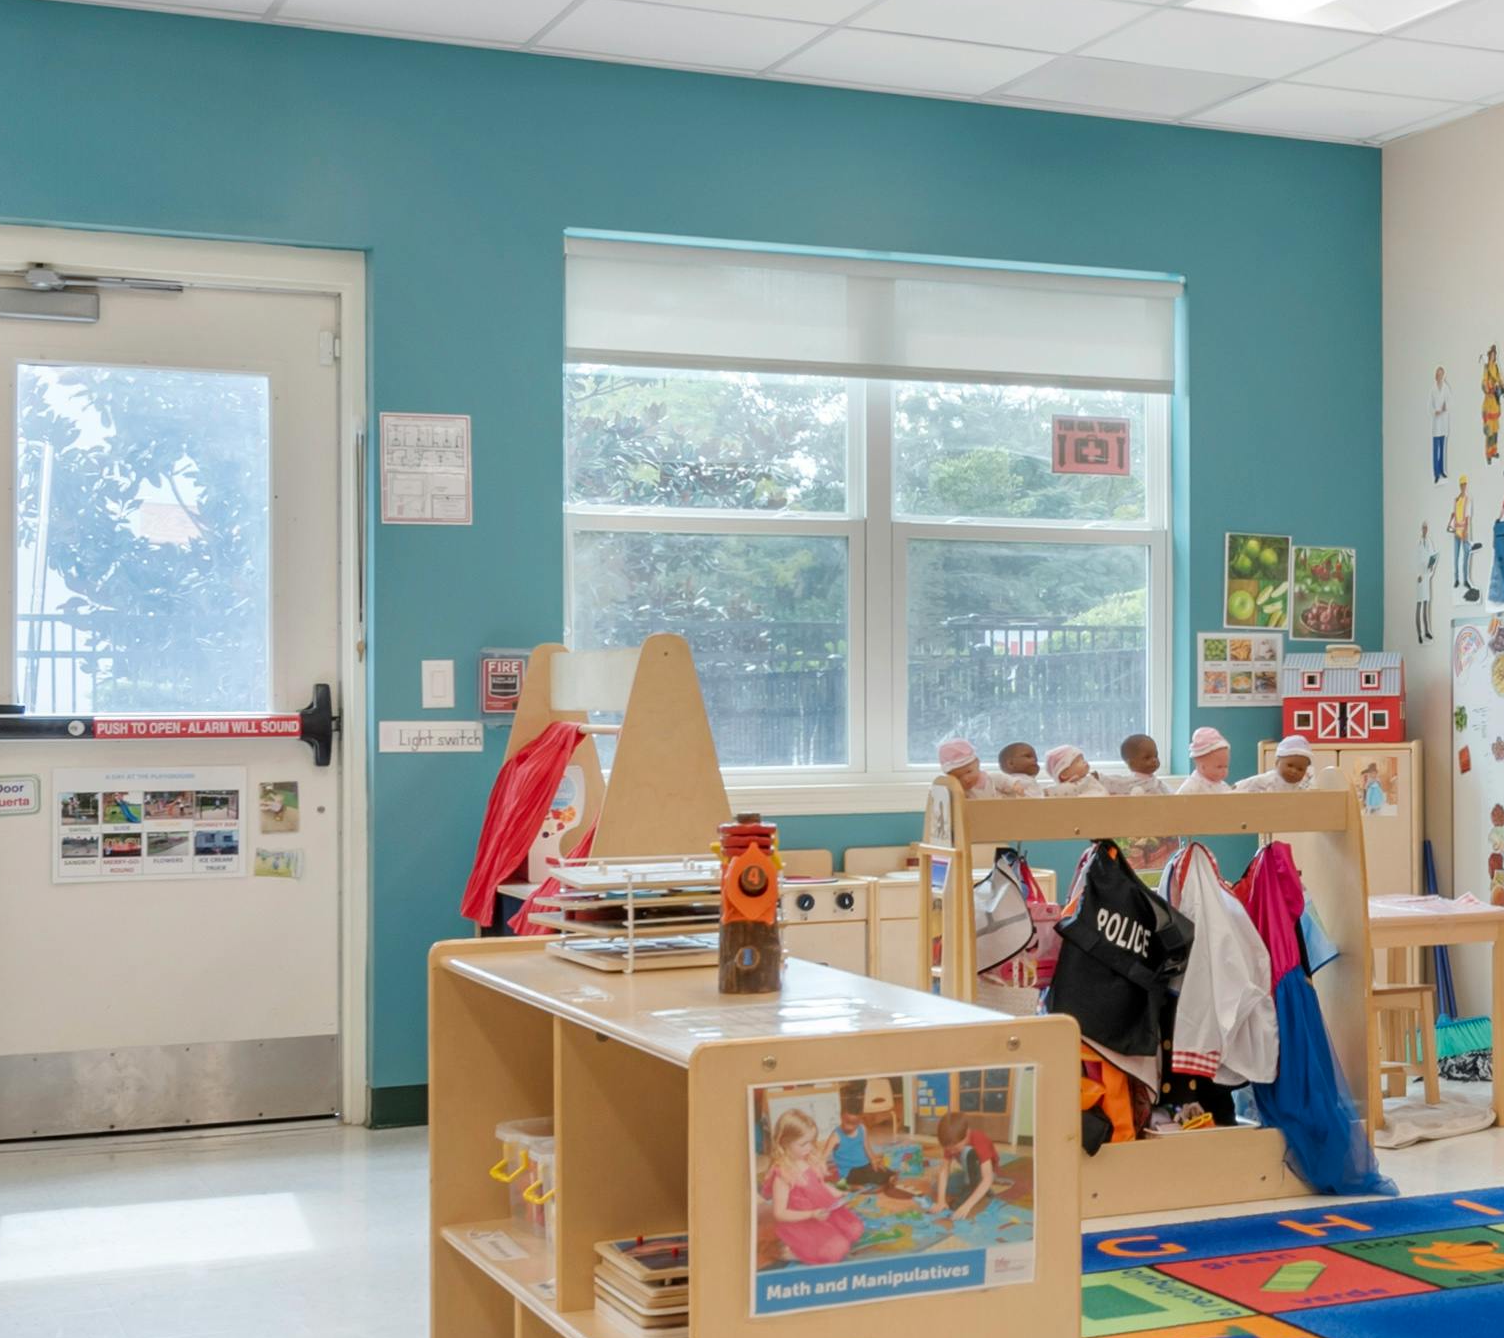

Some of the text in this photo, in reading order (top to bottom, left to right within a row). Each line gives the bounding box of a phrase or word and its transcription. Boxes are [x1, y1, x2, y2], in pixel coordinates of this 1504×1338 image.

[487, 661, 520, 673] FIRE
[96, 719, 301, 736] PUSH TO OPEN ALARM WILL SOUND
[398, 729, 482, 752] Light switch
[745, 867, 761, 886] 4
[1096, 907, 1152, 960] POLICE
[766, 1263, 970, 1302] Math and Manipulatives
